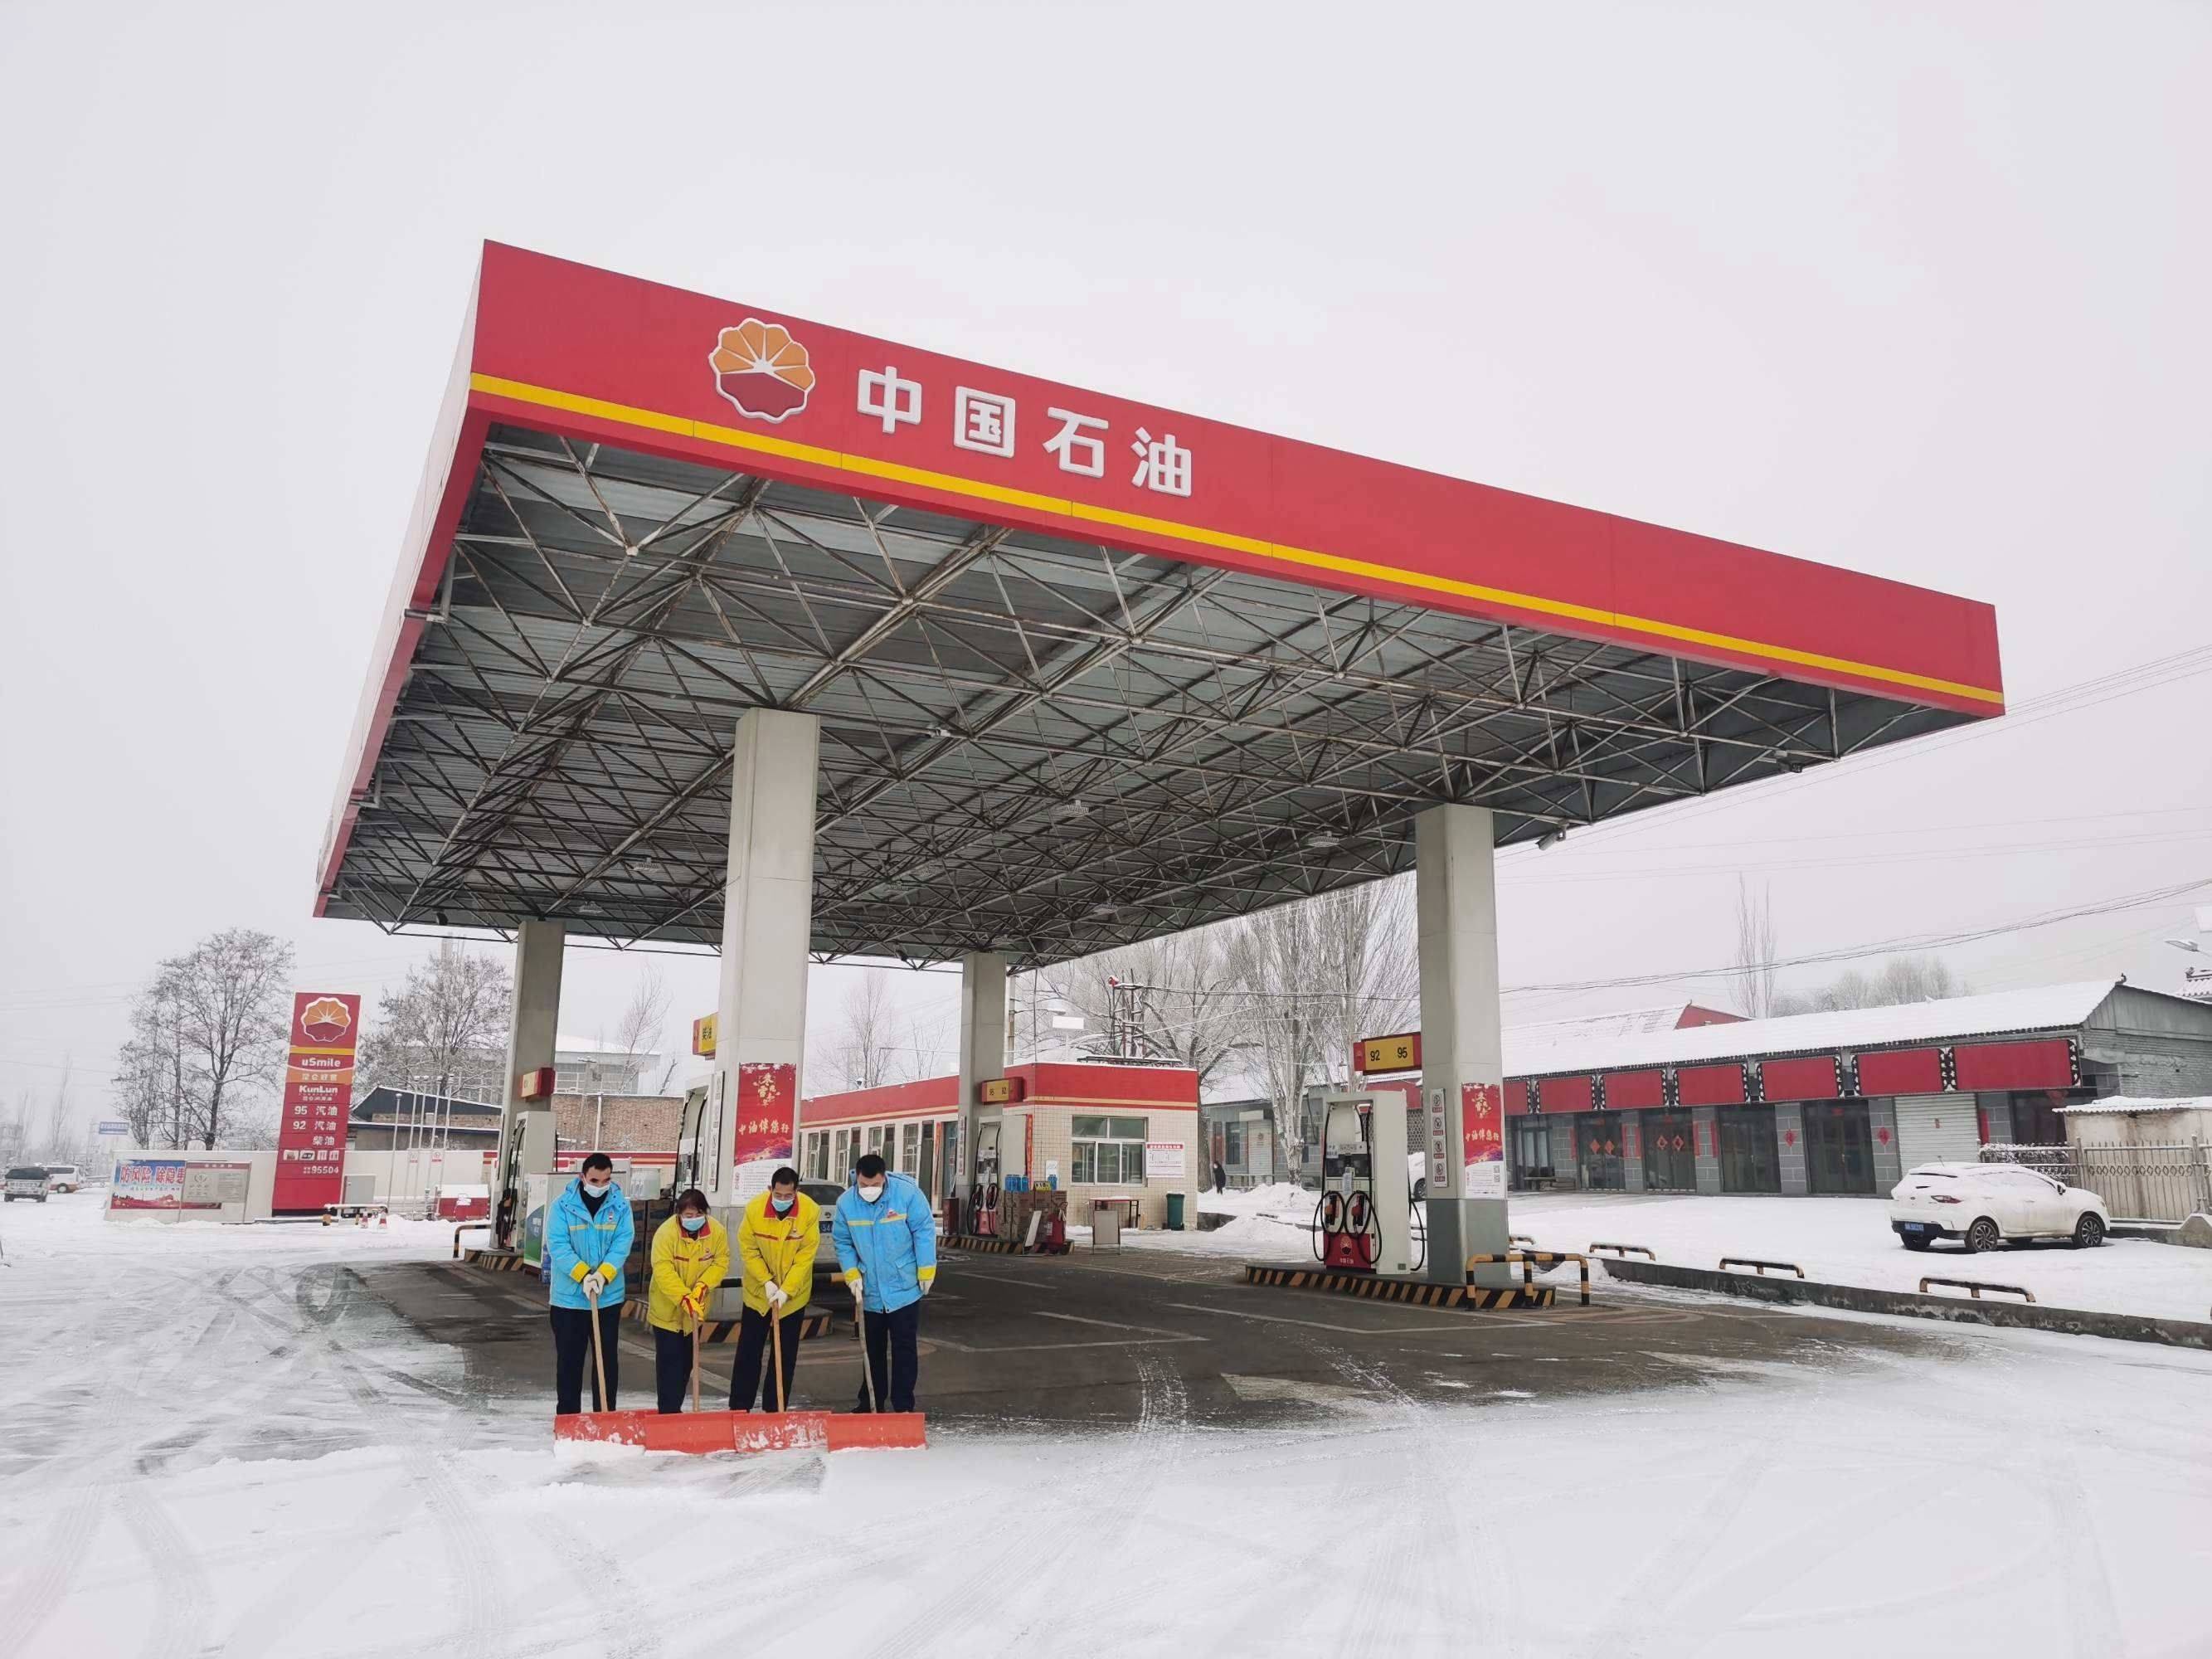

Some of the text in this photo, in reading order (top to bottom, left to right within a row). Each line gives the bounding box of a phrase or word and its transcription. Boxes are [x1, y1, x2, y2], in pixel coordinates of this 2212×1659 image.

[857, 366, 1192, 498] 中国石油
[1369, 1046, 1408, 1062] 92 95
[301, 1057, 342, 1068] uSmile
[299, 1085, 338, 1094] KunLun
[294, 1105, 338, 1117] 95 汽油
[292, 1120, 307, 1130] 92
[119, 1166, 152, 1184] 防风险
[311, 1165, 340, 1175] 95504
